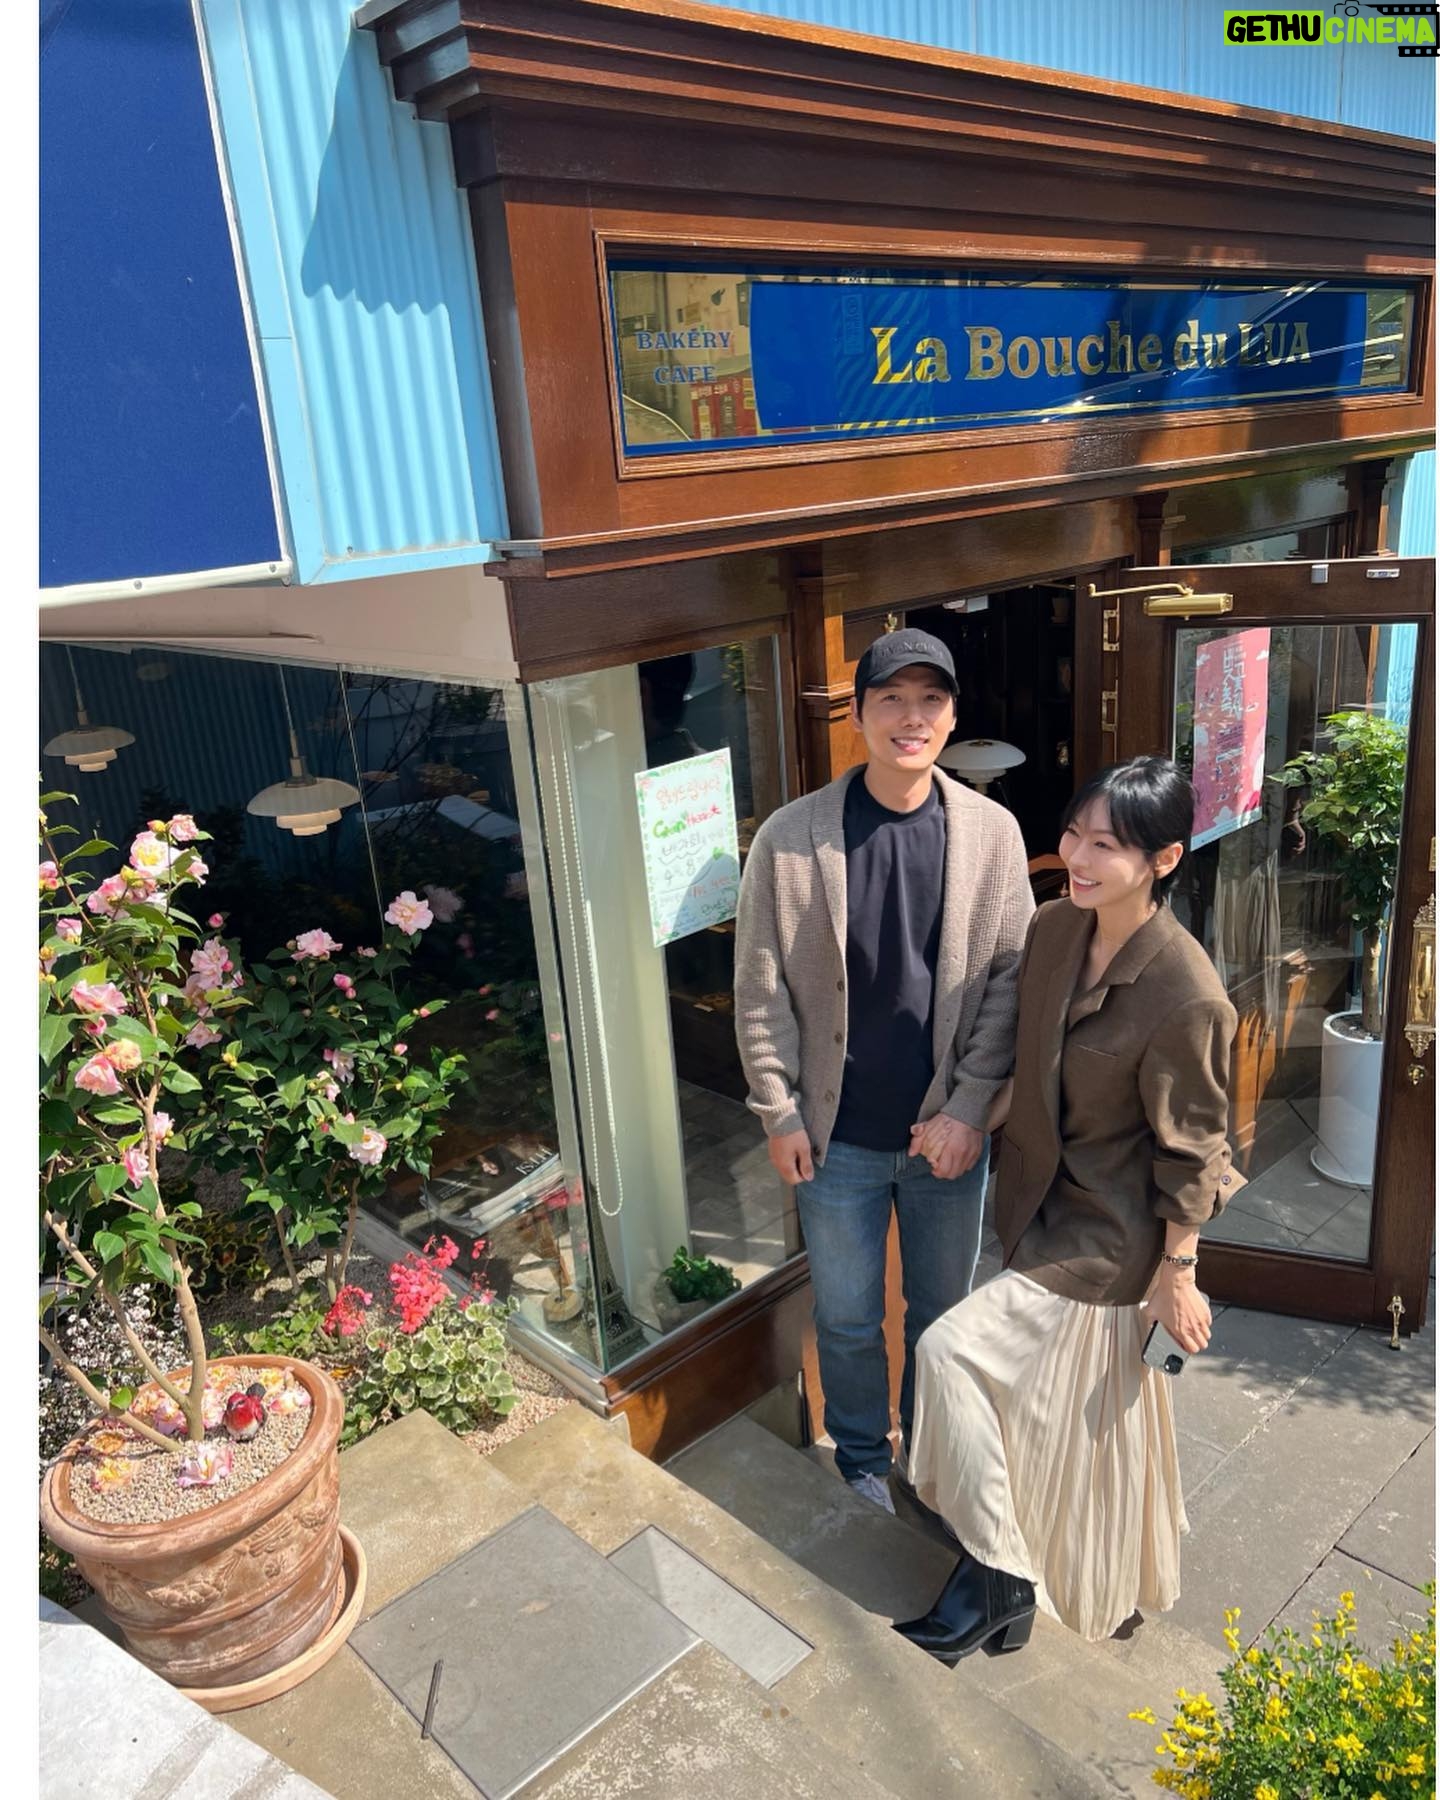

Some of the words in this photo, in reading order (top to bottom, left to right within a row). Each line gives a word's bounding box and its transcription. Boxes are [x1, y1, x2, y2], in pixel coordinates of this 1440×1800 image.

[870, 327, 951, 384] La
[964, 320, 1162, 380] Bouche
[1173, 319, 1227, 371] du
[1238, 321, 1312, 367] LUA
[654, 366, 717, 384] CAFE
